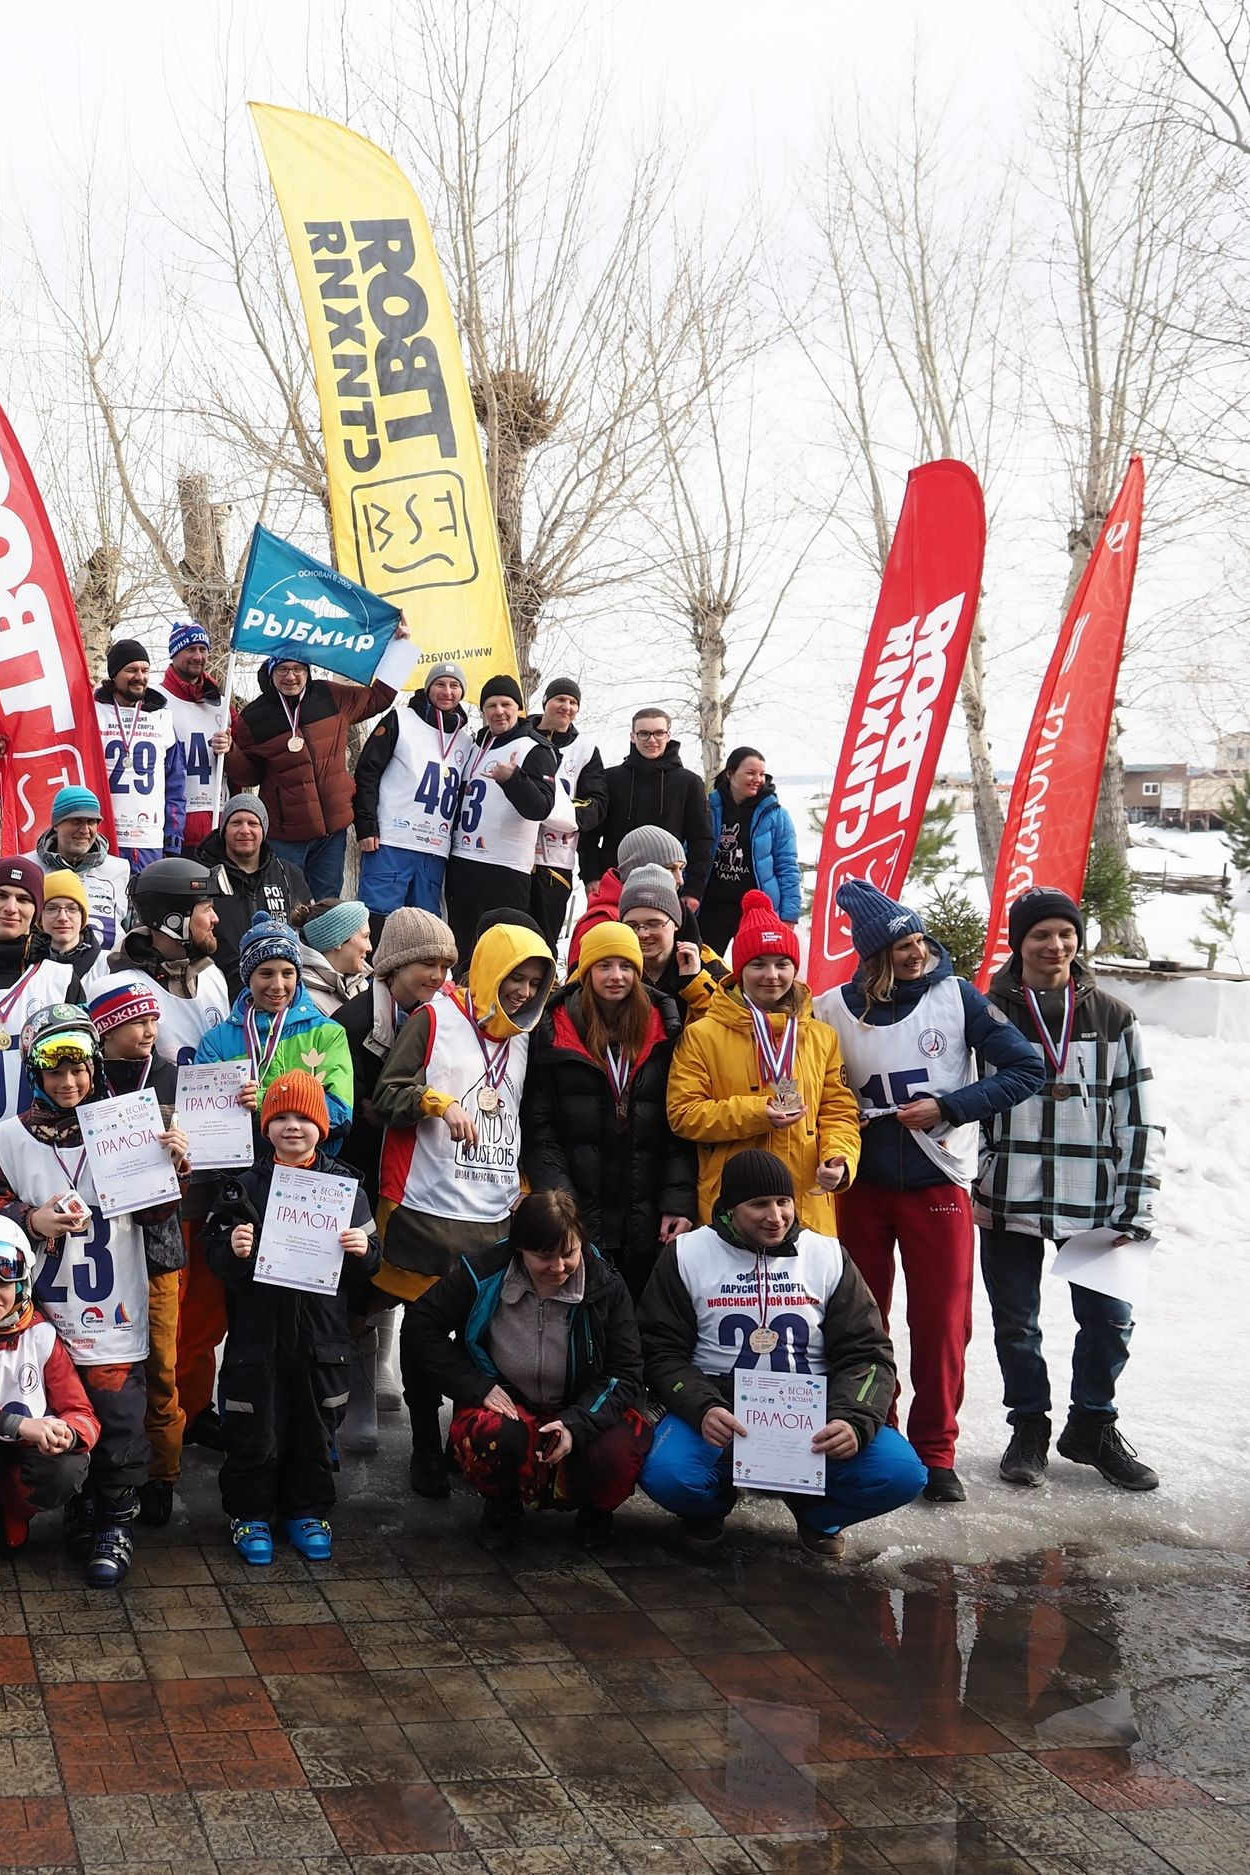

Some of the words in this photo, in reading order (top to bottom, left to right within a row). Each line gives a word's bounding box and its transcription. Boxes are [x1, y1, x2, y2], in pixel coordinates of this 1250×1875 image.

[242, 608, 375, 652] РЫБМИР
[105, 740, 156, 795] 29
[414, 761, 460, 820] 48
[267, 899, 285, 910] INT
[185, 1095, 240, 1111] ГРАМОТА
[96, 1129, 157, 1156] ГРАМОТА
[277, 1205, 338, 1232] ГРАМОТА
[788, 1387, 813, 1396] ВЕСНА
[746, 1410, 813, 1431] ГРАМОТА
